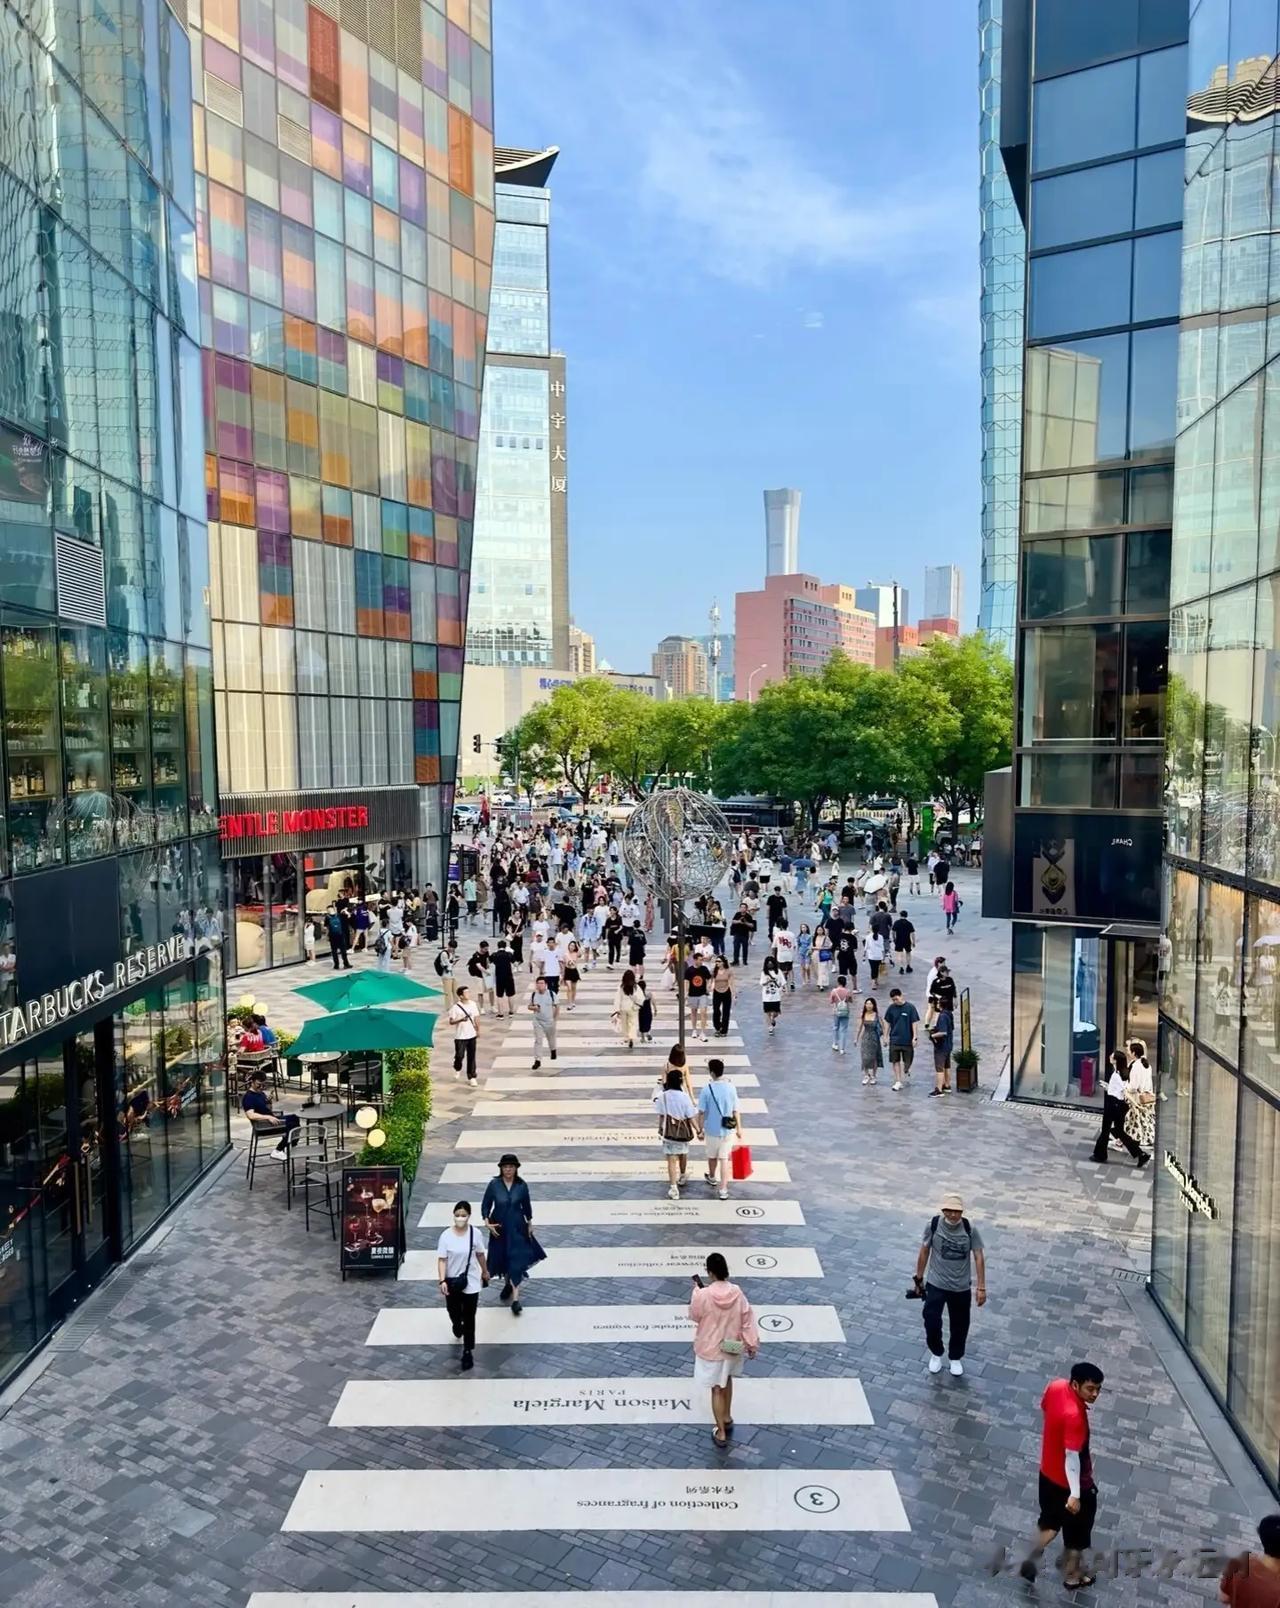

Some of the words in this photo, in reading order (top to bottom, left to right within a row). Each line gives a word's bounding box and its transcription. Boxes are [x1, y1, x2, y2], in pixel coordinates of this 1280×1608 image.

[550, 380, 567, 493] 中宇大厦
[283, 806, 369, 834] MONSTER
[0, 969, 105, 1046] TARBUCKS
[114, 933, 184, 989] RESERVE
[741, 1208, 760, 1216] 10
[756, 1258, 767, 1266] 8
[633, 1323, 649, 1331] for
[770, 1317, 783, 1329] 4
[513, 1397, 605, 1413] Margiela
[615, 1398, 691, 1411] Maison
[577, 1498, 648, 1510] fragrances
[651, 1499, 667, 1510] of
[669, 1499, 739, 1510] Collection
[809, 1491, 825, 1507] 3
